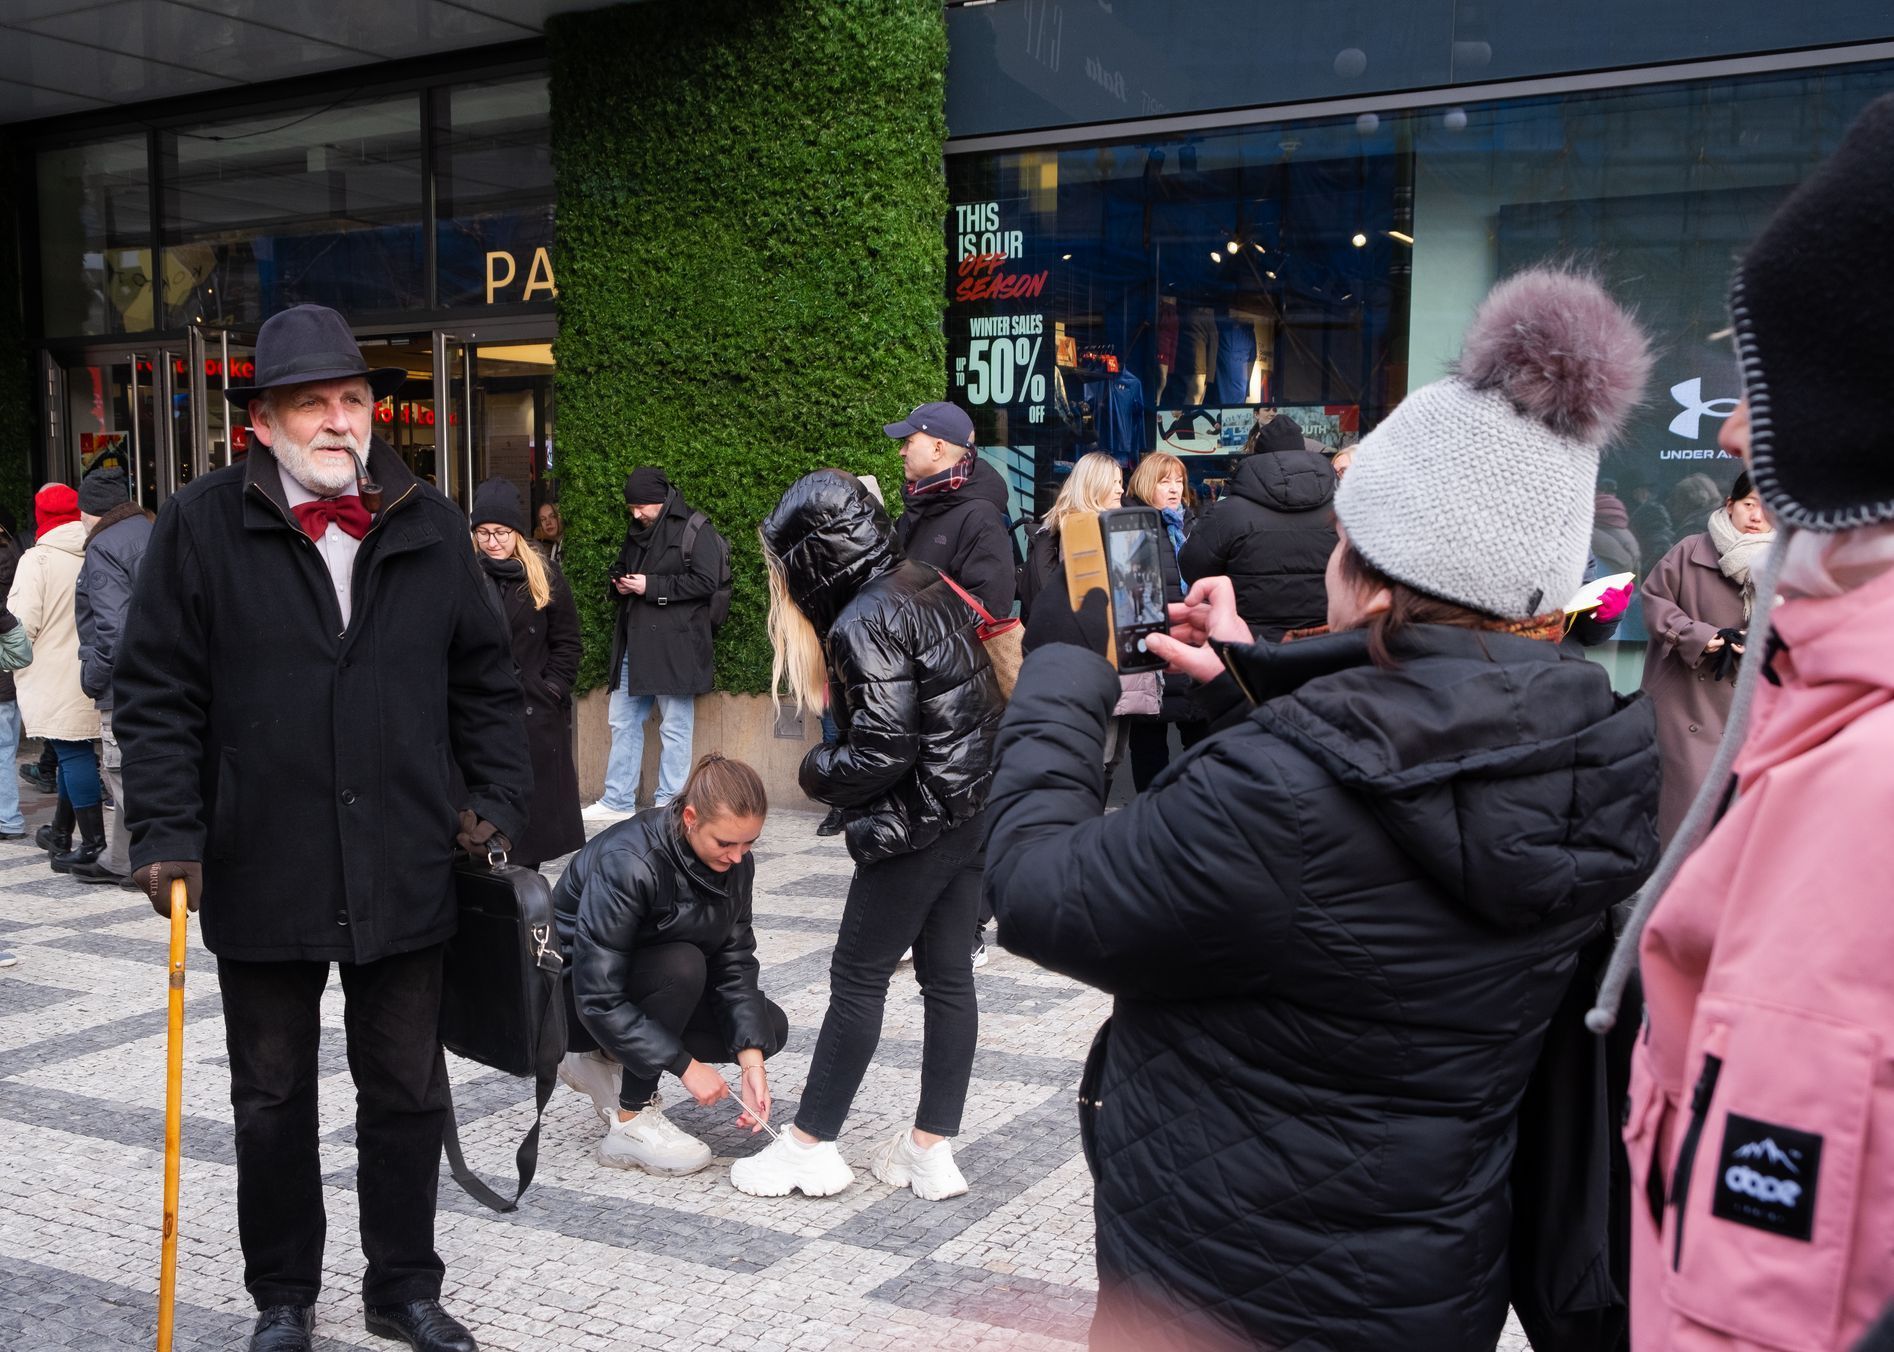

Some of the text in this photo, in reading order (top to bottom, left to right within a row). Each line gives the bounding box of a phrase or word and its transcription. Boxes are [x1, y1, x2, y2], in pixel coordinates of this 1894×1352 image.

[956, 202, 1000, 233] THIS
[958, 230, 1023, 262] IS OUR
[958, 252, 1007, 277] OFF
[956, 270, 1048, 301] SEASON
[970, 314, 1043, 337] WINTER SALES
[956, 357, 966, 371] UP
[967, 337, 1046, 405] 50%
[956, 372, 965, 386] TO
[1028, 405, 1046, 423] OFF
[1660, 449, 1714, 460] UNDER
